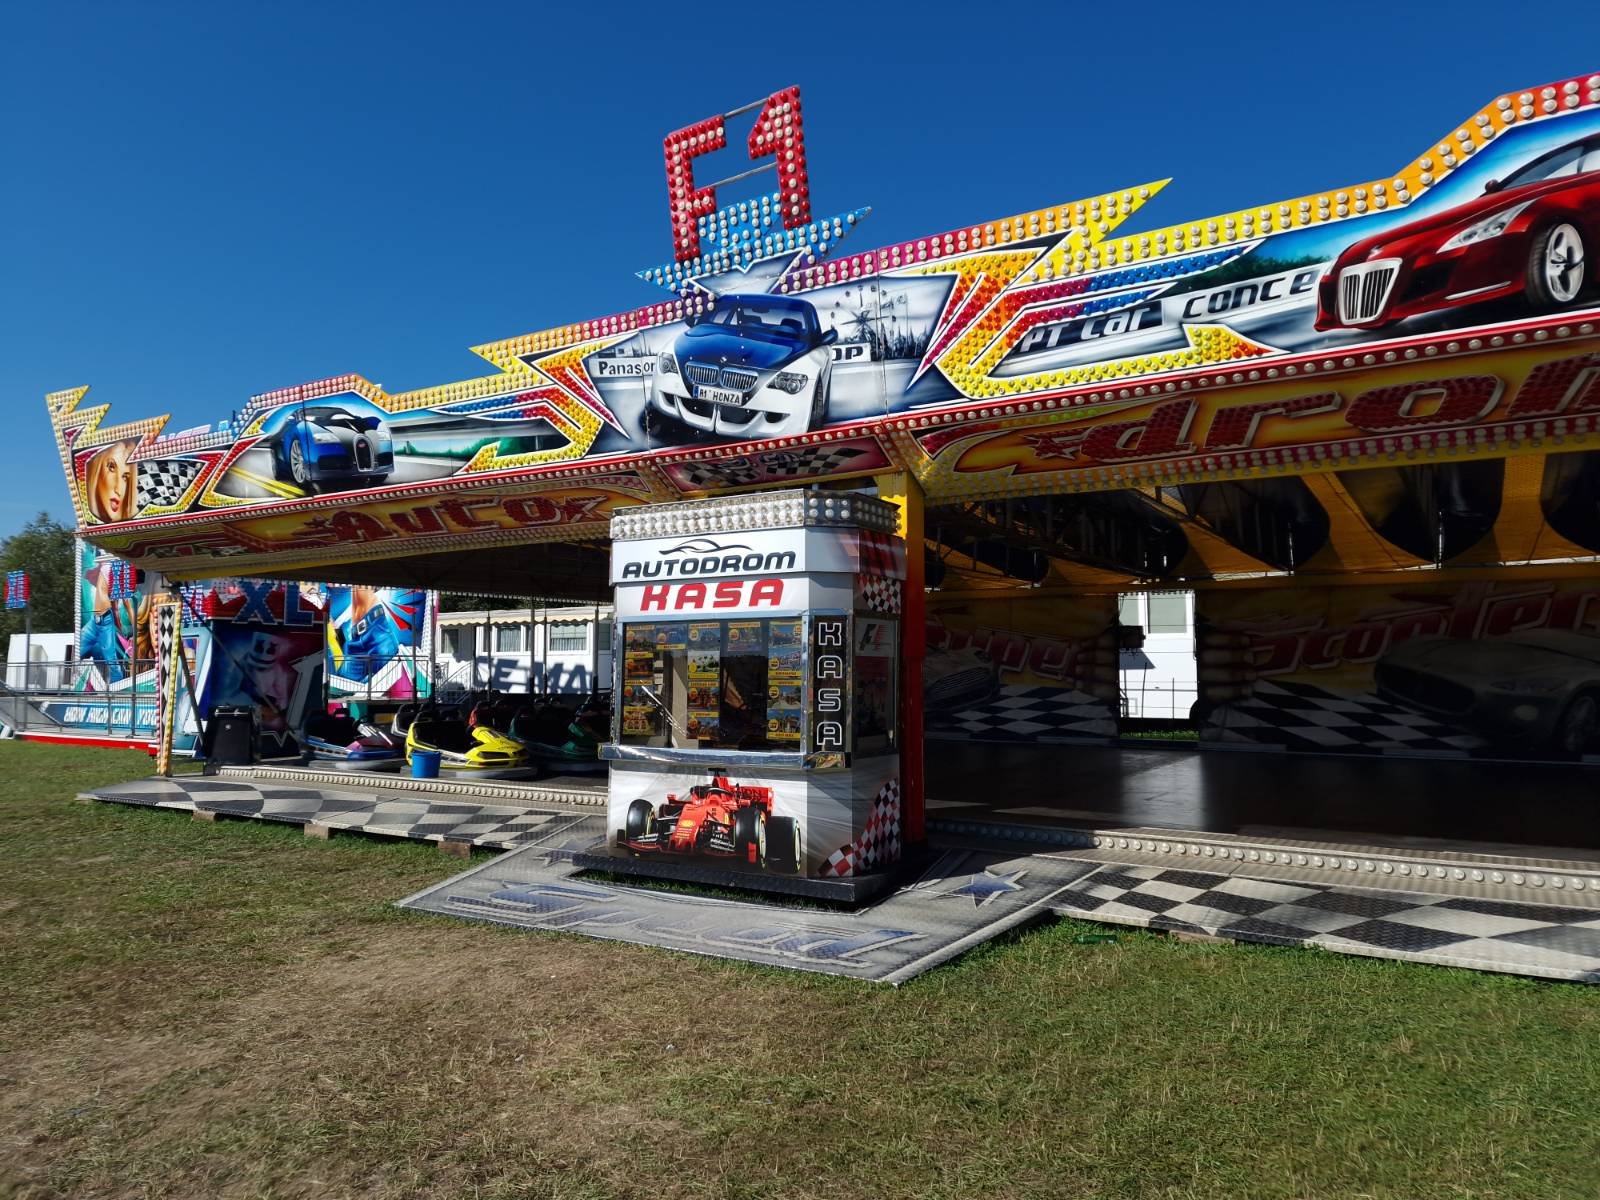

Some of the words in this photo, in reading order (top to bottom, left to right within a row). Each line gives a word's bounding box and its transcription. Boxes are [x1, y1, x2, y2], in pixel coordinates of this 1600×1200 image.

[663, 85, 812, 262] F1
[1183, 270, 1321, 319] conce
[712, 390, 740, 404] HONZA
[622, 551, 796, 579] AUTODROM
[640, 579, 784, 611] KASA
[817, 622, 843, 746] KASA
